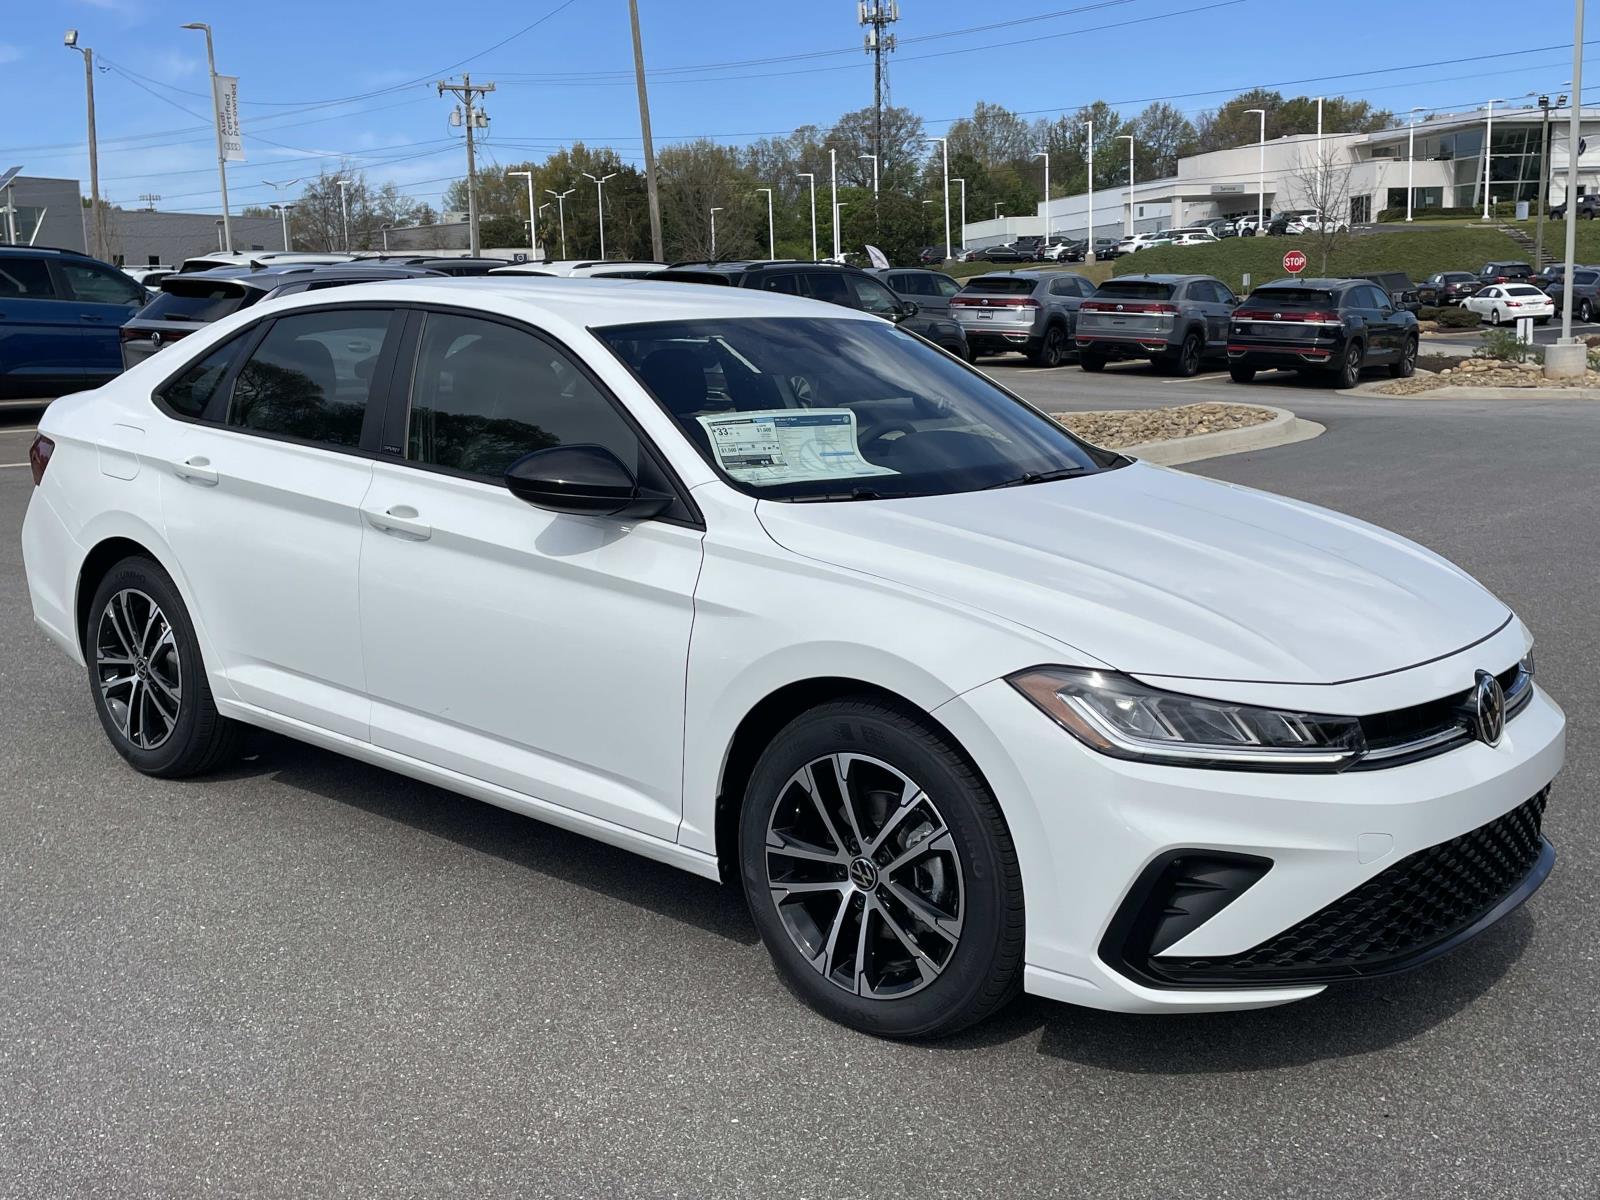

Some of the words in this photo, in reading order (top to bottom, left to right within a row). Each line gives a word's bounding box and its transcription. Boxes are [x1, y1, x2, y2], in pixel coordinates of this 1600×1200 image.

[224, 94, 234, 136] Certified
[231, 83, 240, 137] Pre-owned
[1285, 257, 1305, 267] STOP
[717, 427, 729, 436] 33
